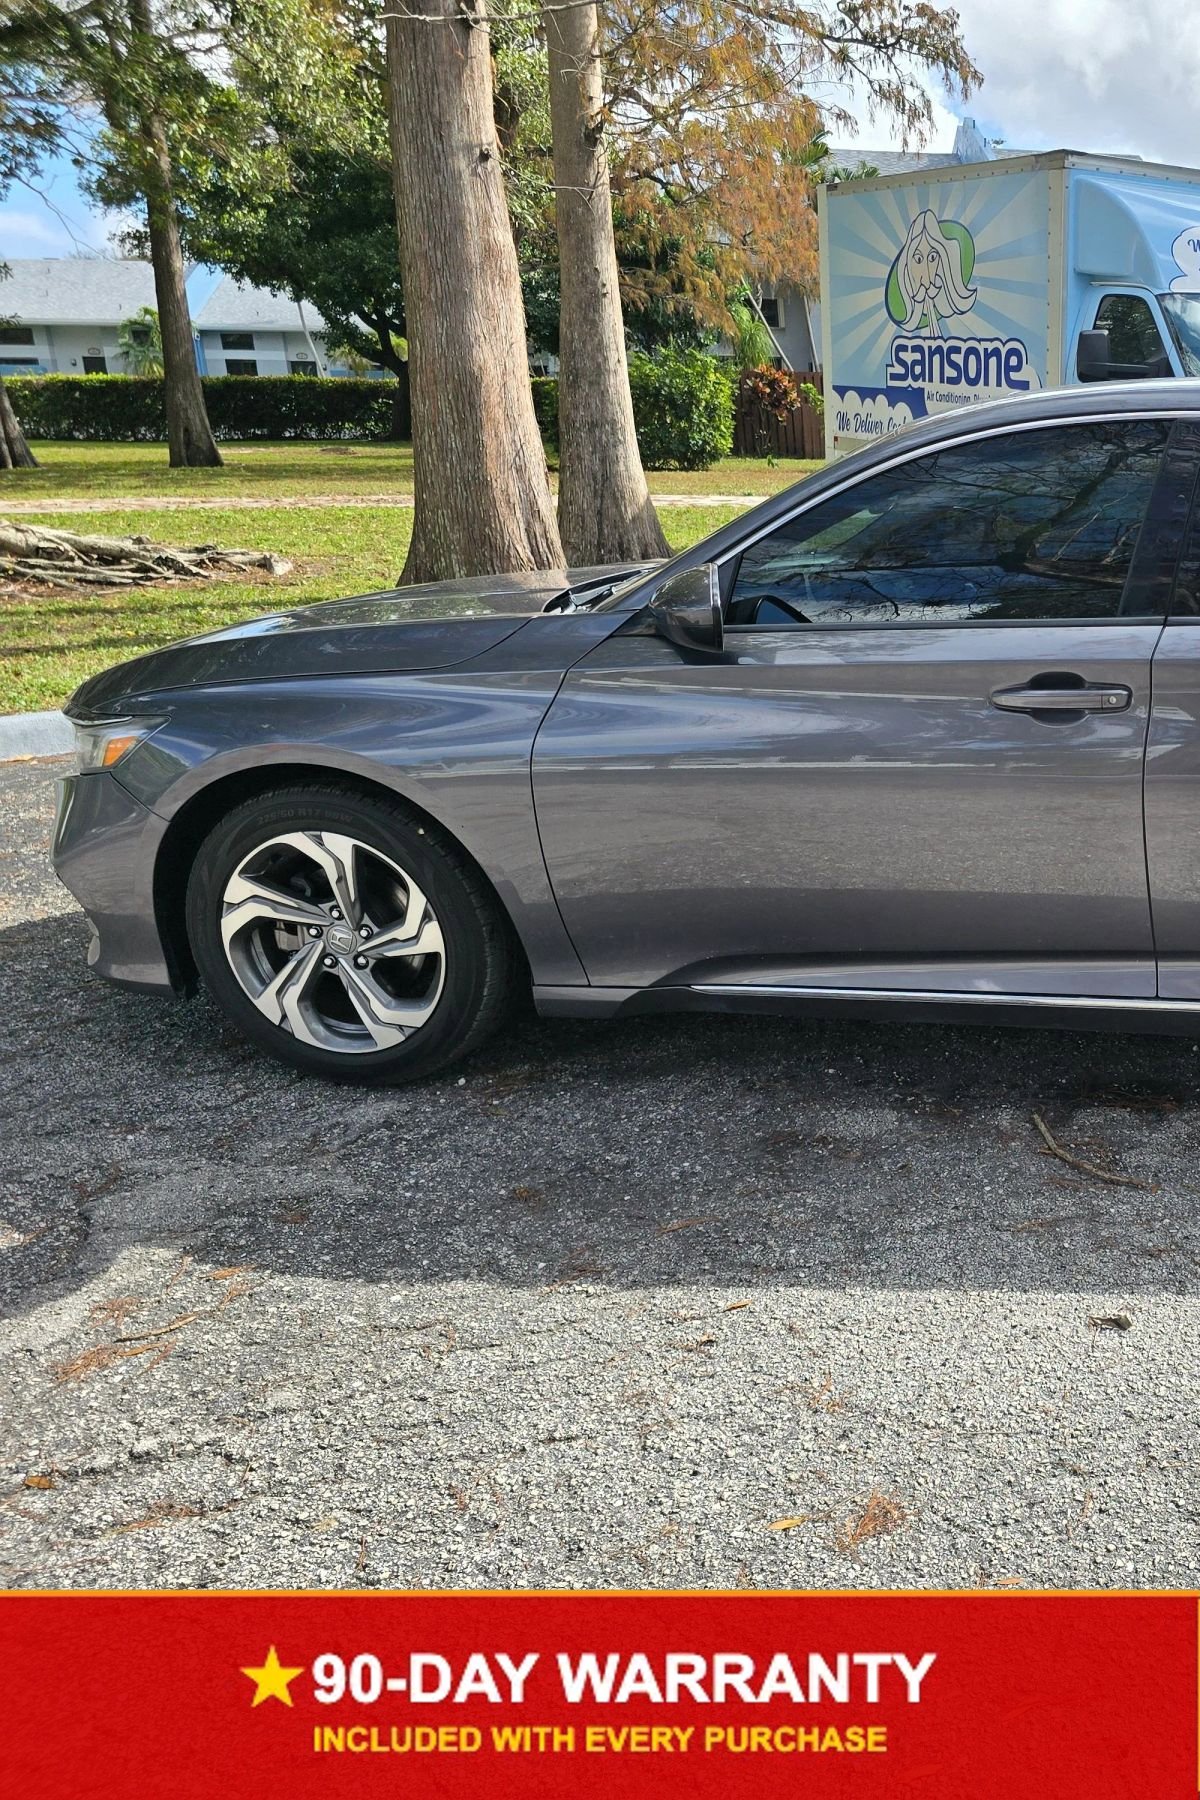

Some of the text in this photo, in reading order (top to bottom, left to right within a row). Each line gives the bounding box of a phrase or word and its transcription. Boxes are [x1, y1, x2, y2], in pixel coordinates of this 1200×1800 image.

[889, 343, 1030, 390] sansone
[836, 410, 850, 432] We
[854, 412, 883, 435] Deliver
